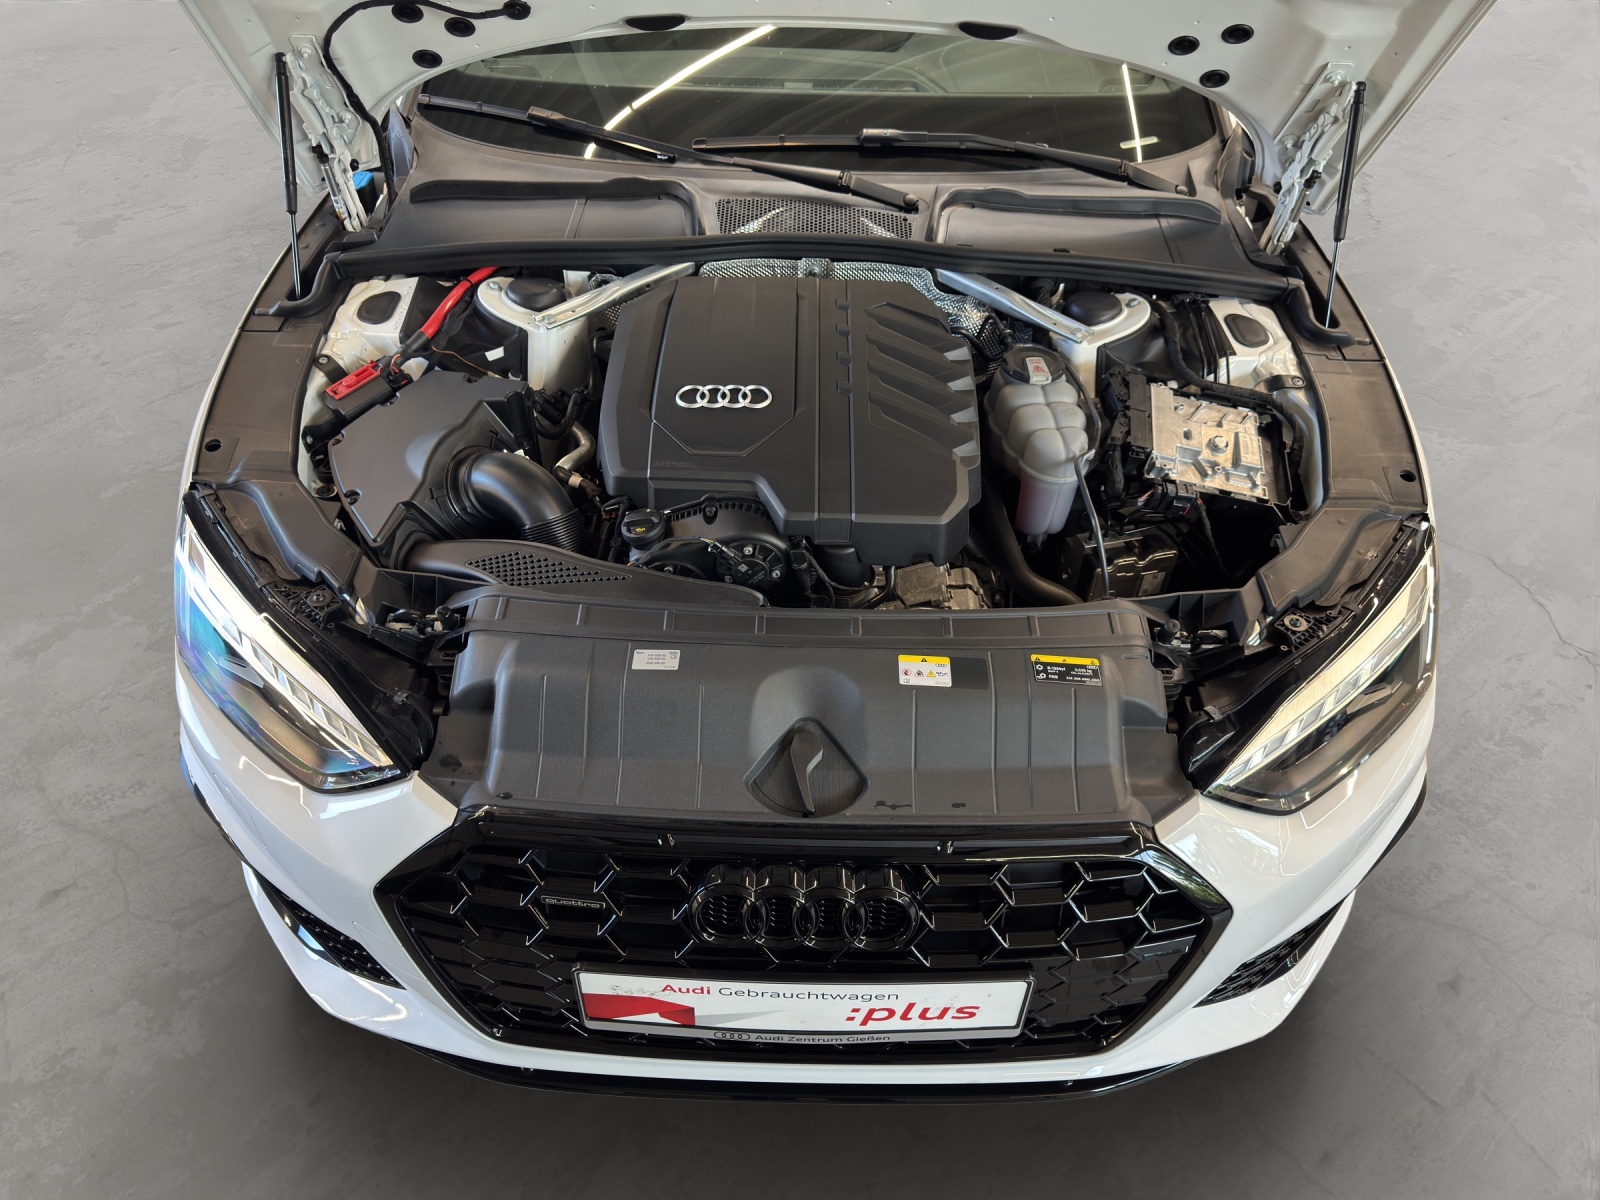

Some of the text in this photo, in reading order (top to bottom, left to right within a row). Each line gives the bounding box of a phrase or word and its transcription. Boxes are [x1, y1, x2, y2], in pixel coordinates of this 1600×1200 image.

[545, 898, 600, 908] quattro
[661, 984, 899, 1003] Audi Gebrauchtwagen
